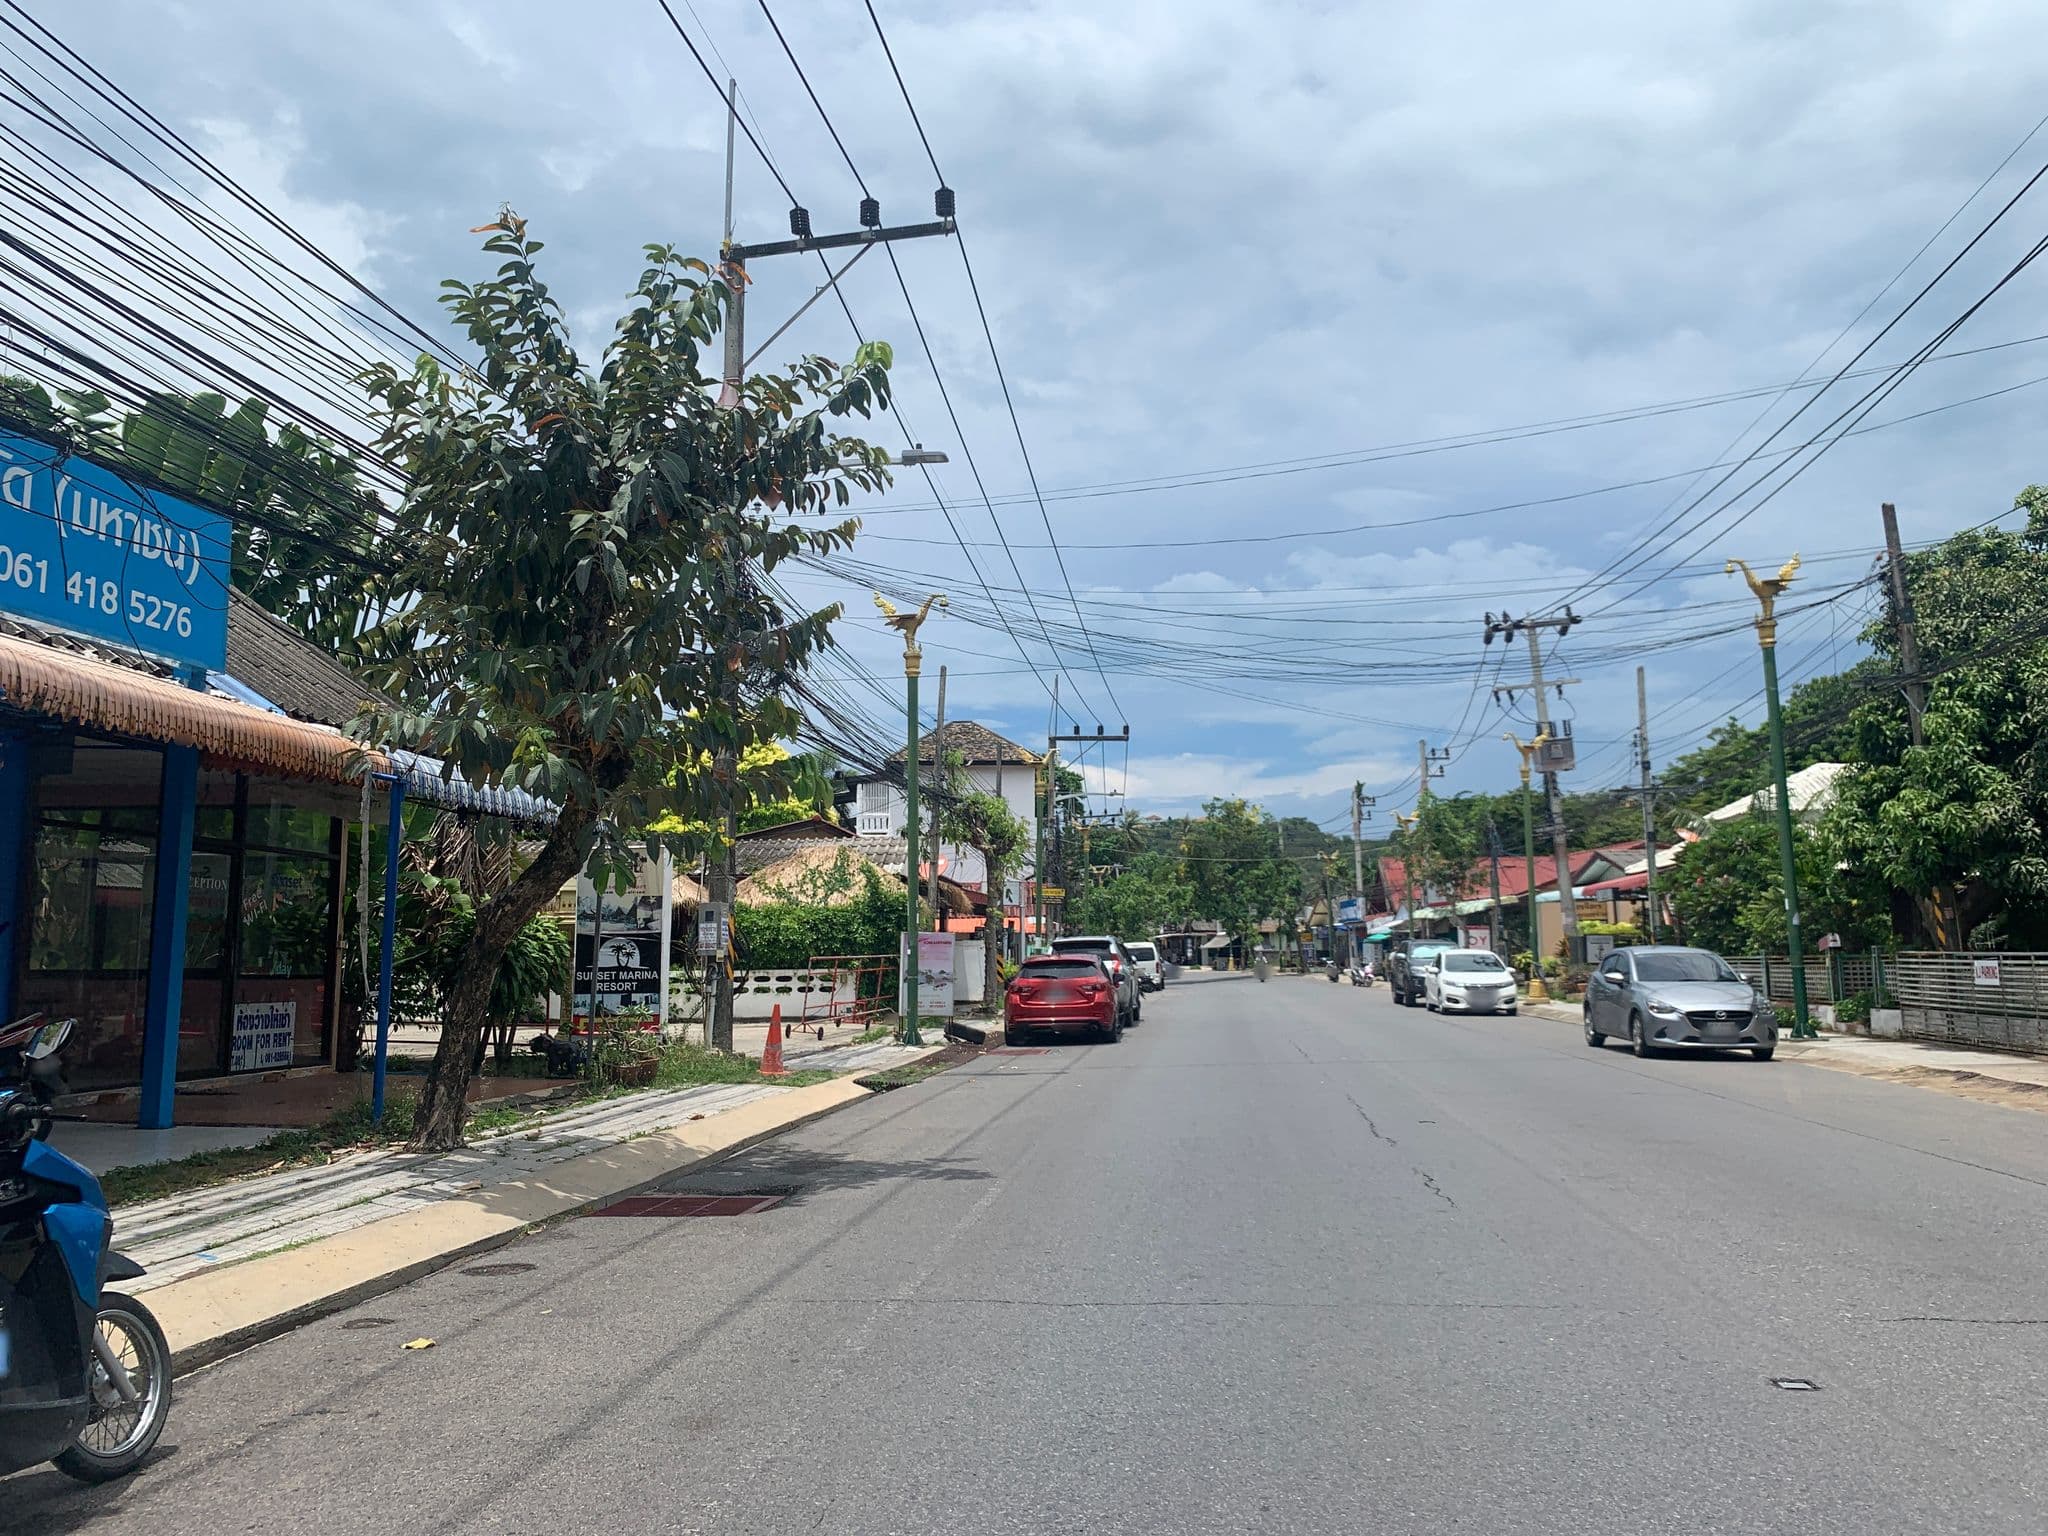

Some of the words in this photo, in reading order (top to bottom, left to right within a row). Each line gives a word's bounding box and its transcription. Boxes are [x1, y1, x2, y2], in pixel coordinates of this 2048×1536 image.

[55, 475, 200, 585] (มหาชน)
[0, 545, 48, 594] 061
[66, 571, 119, 615] 418
[129, 590, 192, 638] 5276
[620, 970, 659, 980] MARINA
[596, 982, 638, 992] RESORT
[232, 1034, 253, 1051] ROOM
[256, 1033, 271, 1049] FOR
[273, 1031, 292, 1048] RENT
